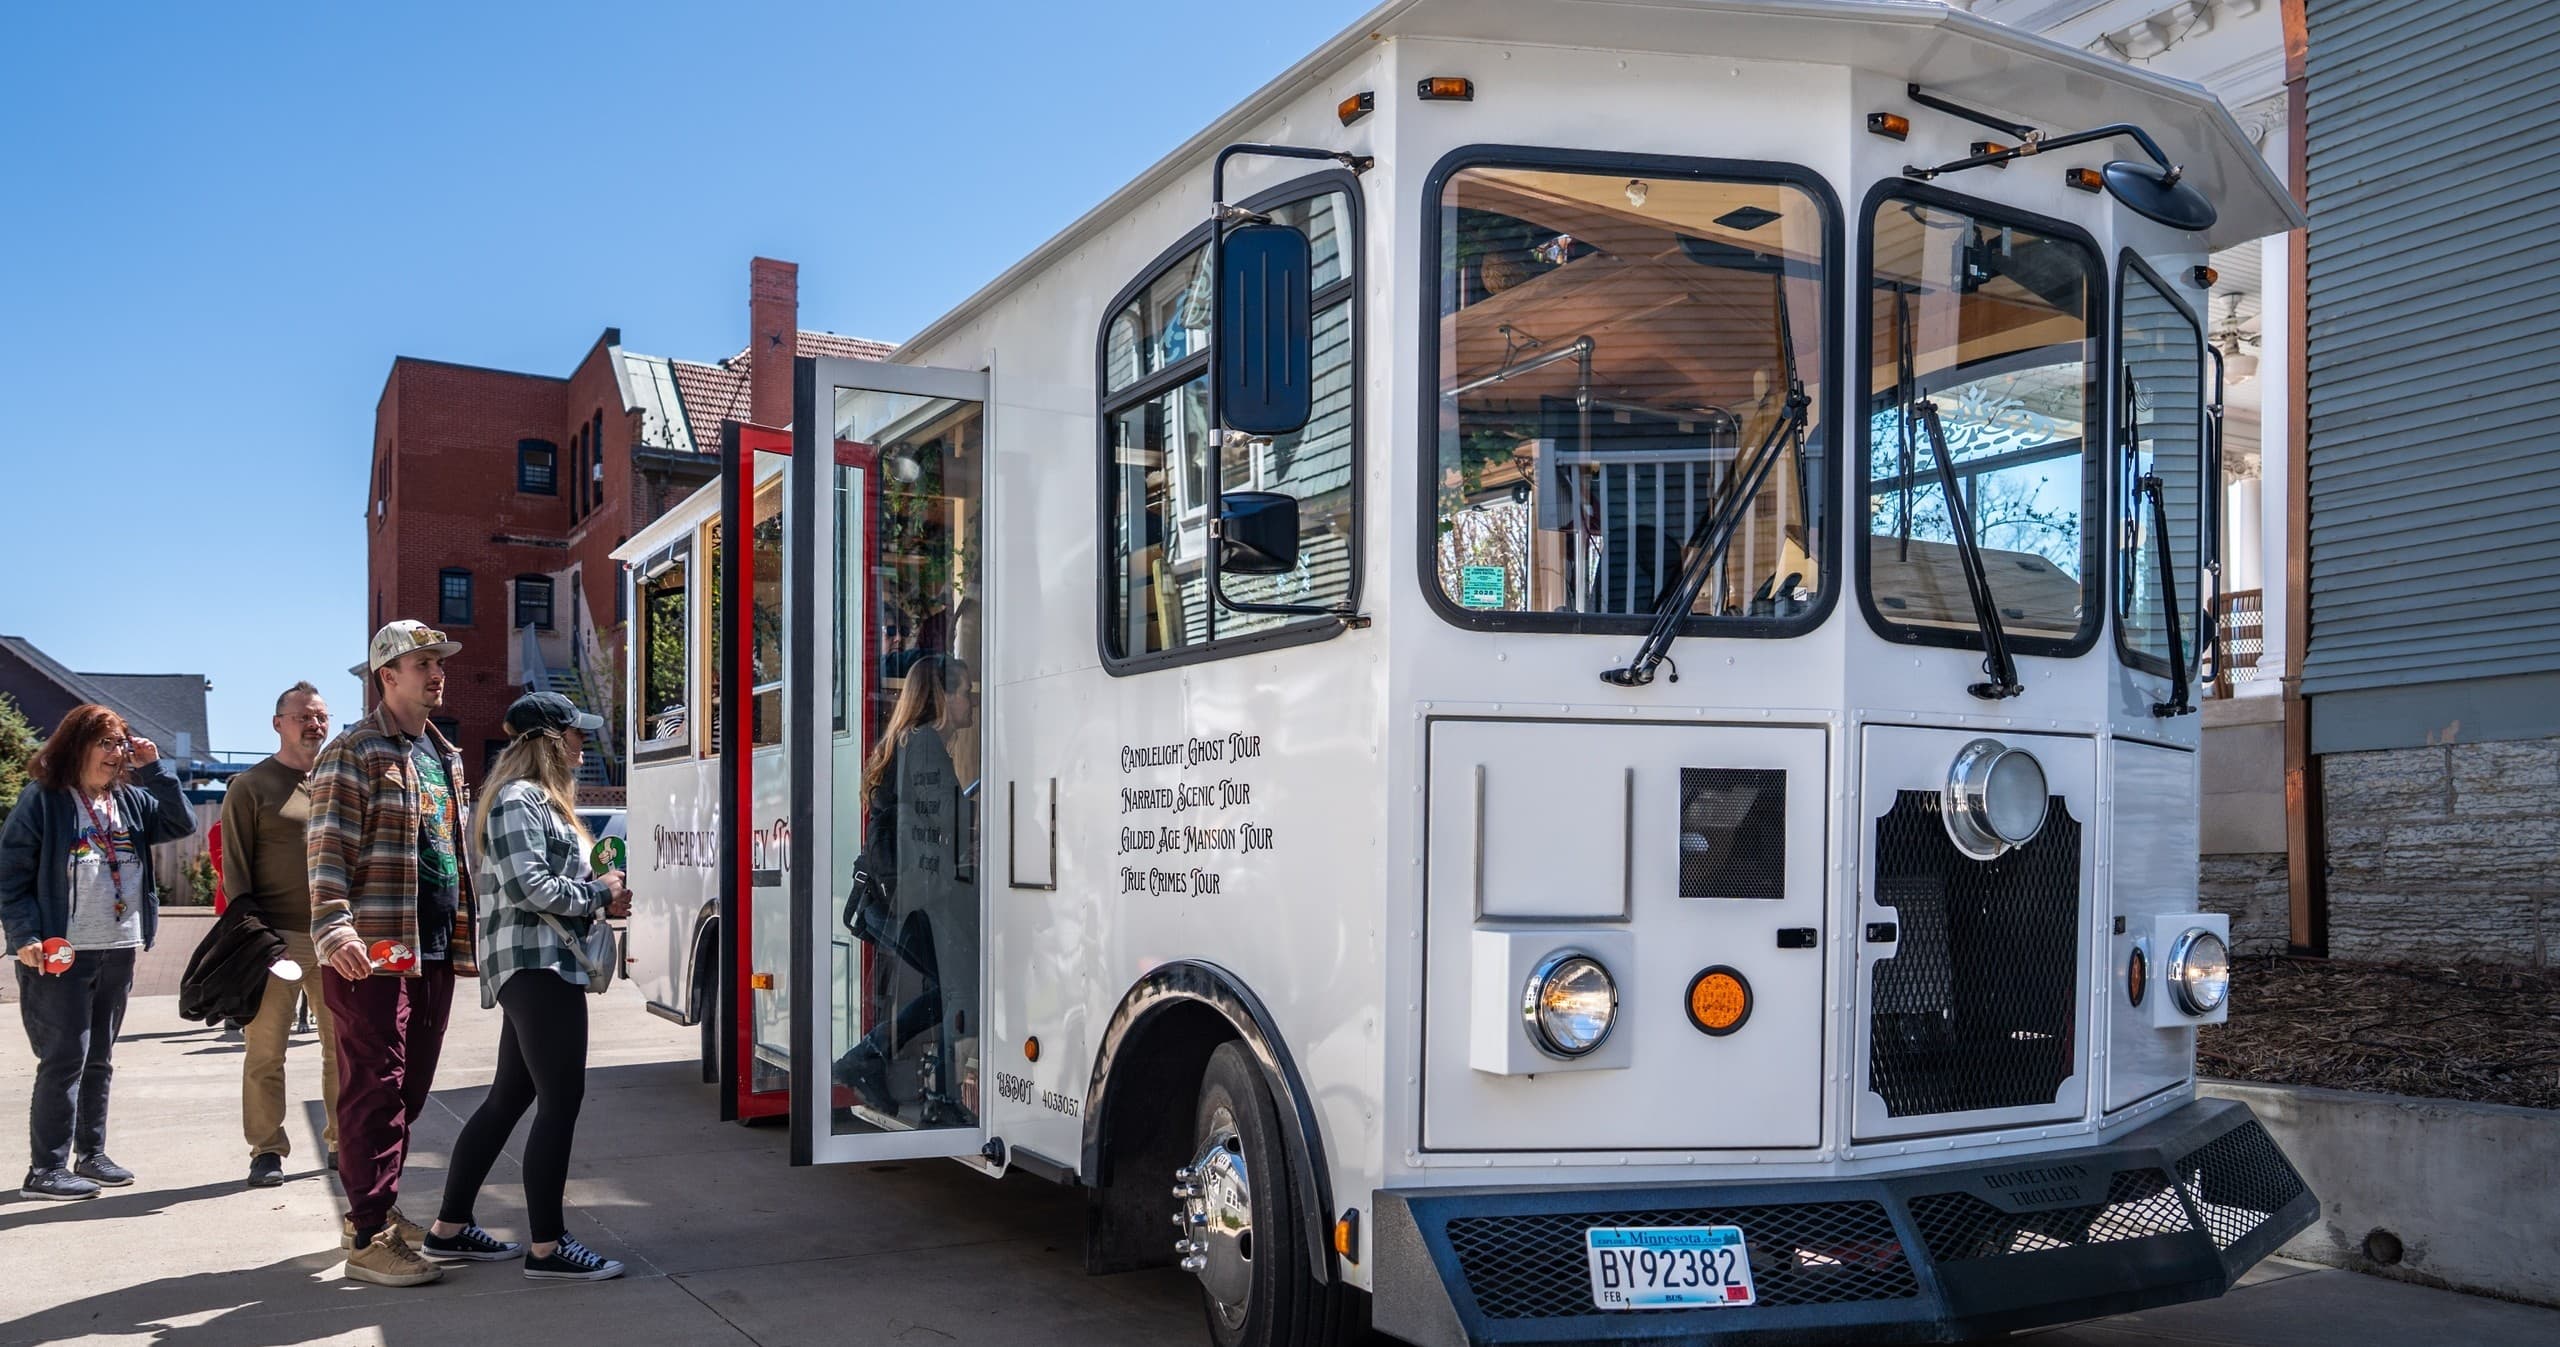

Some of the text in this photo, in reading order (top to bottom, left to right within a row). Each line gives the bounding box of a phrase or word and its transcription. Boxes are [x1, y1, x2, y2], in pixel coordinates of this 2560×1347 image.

[1121, 731, 1261, 773] CANDLELIGHT GHOST TOUR
[1121, 777, 1251, 814] NARRATED SCENIC TOUR
[653, 824, 716, 871] MINNEAPOLIS
[1117, 821, 1274, 856] GILDED AGE MANSION TOUR
[1120, 865, 1220, 898] TRUE CRIMES TOUR
[996, 1071, 1079, 1117] USDOT 4033057
[1982, 1163, 2089, 1189] HOMETOWN
[2008, 1185, 2082, 1207] TROLLEY
[1600, 1248, 1741, 1289] BY92382
[1604, 1290, 1622, 1302] FEB
